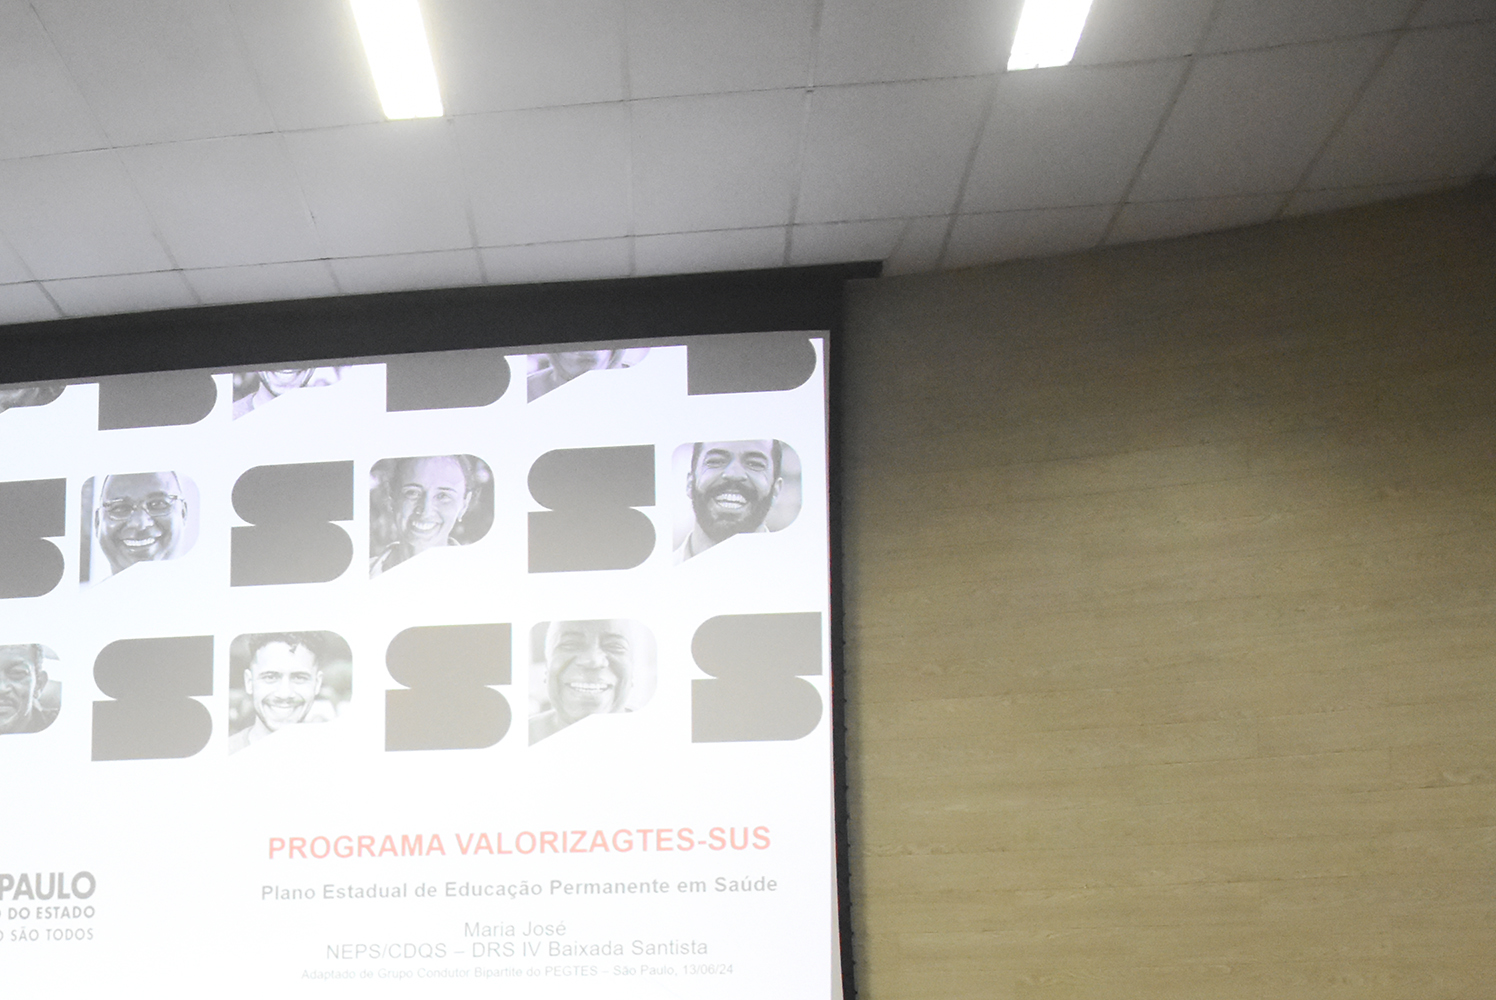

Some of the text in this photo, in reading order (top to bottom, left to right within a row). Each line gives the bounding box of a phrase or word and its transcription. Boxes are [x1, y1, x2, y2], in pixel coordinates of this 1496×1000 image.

[269, 826, 770, 859] PROGRAMA VALORIZAGTES-SUS
[262, 876, 777, 900] Plano Estadual de Educação Permanente em Saúde
[8, 907, 30, 920] DO
[36, 905, 95, 919] ESTADO
[11, 926, 39, 942] SÃO
[46, 928, 93, 941] TODOS
[465, 921, 566, 937] Maria José
[473, 942, 515, 957] DRS
[523, 941, 541, 957] IV
[549, 941, 623, 956] Baixada
[632, 940, 707, 955] Santista
[301, 969, 356, 981] Adaptado
[359, 969, 374, 979] de
[378, 968, 413, 980] Grupo
[417, 968, 471, 978] Condutor
[474, 967, 523, 979] Bipartite
[526, 967, 541, 977] do
[545, 965, 598, 976] PEGTES
[613, 965, 636, 976] São
[640, 964, 678, 976] Paulo,
[683, 964, 733, 975] 13/06/24
